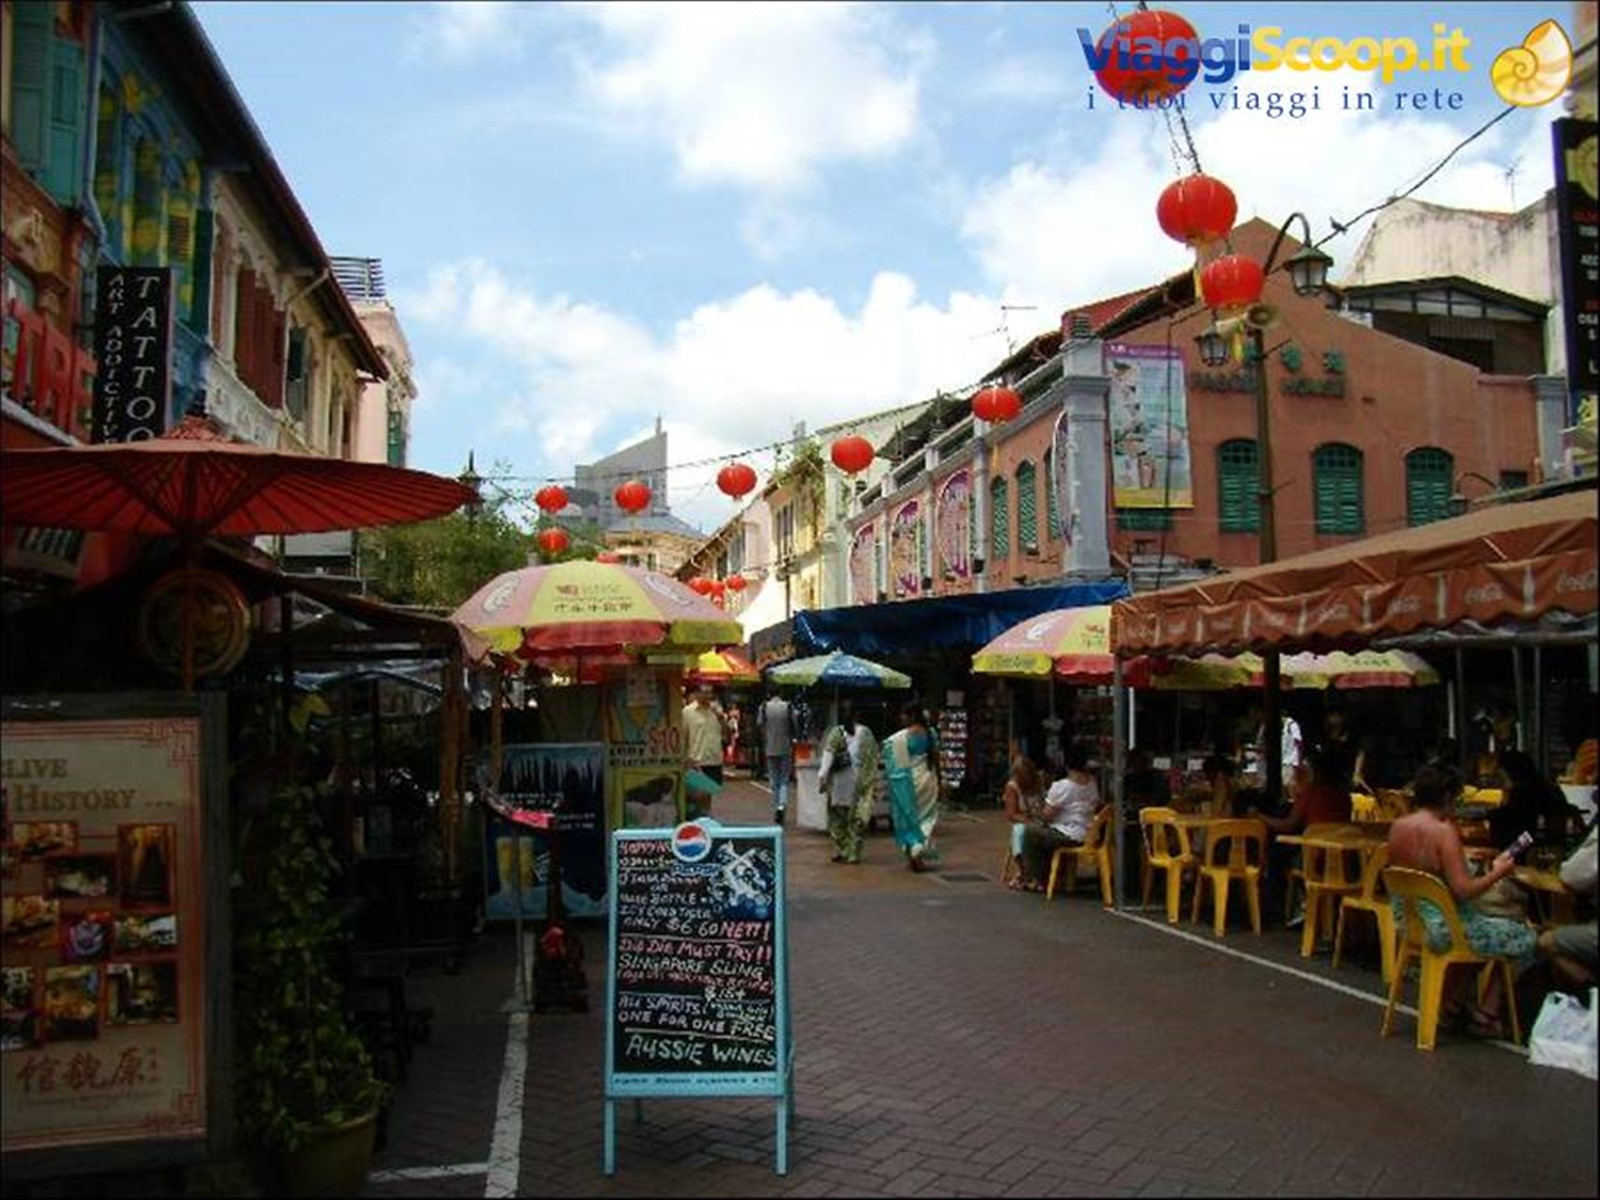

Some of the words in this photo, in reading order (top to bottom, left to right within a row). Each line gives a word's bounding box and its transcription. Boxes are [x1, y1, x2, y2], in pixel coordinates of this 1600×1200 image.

[12, 783, 138, 812] HISTORY
[677, 941, 721, 959] MUST
[618, 953, 707, 974] SINGAPORE
[708, 959, 765, 981] SLING
[618, 1011, 652, 1025] ONE
[658, 1013, 688, 1029] FOR
[692, 1020, 726, 1033] ONE
[730, 1020, 777, 1041] FREE
[625, 1033, 706, 1066] AUSSIE
[711, 1043, 777, 1066] WINES
